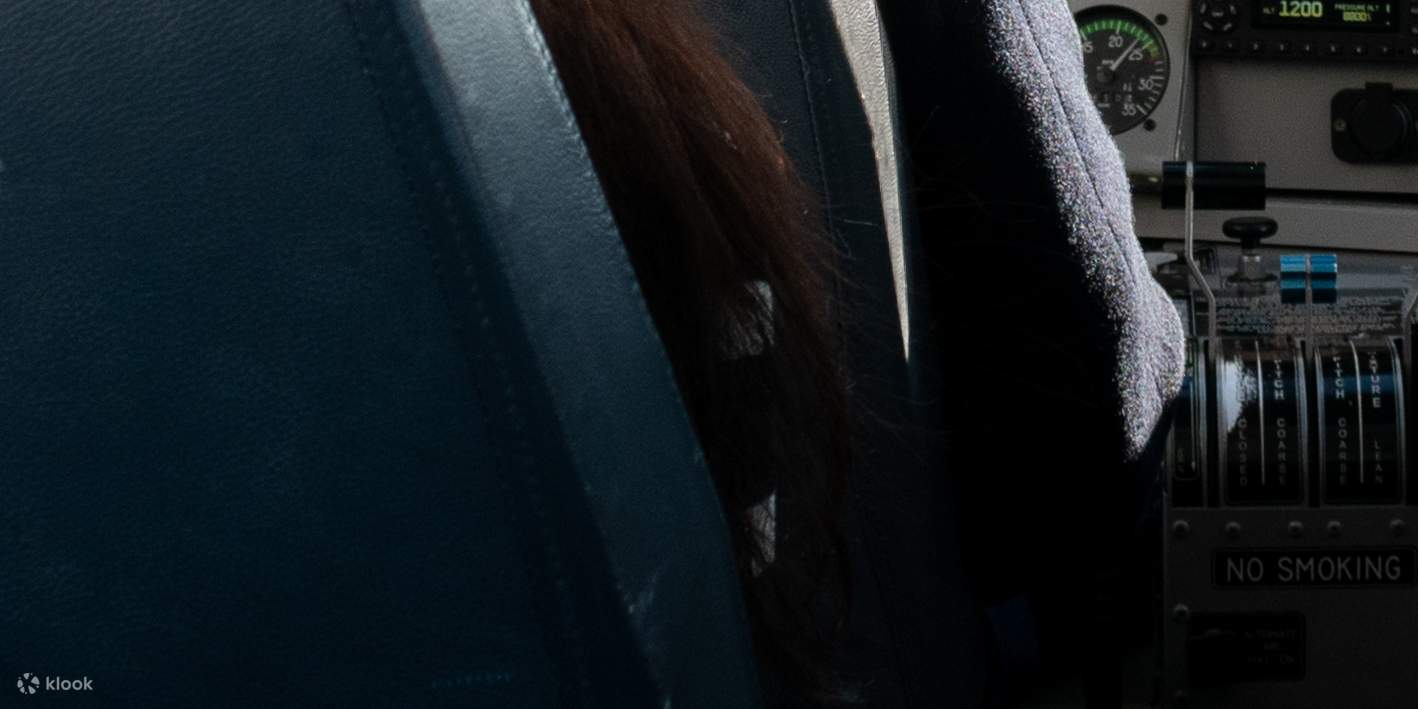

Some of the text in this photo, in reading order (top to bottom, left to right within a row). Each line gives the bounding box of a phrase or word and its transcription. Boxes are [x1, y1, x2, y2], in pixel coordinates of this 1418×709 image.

[1279, 0, 1323, 18] 1200
[1108, 35, 1124, 48] 20
[1138, 78, 1154, 91] 30
[1225, 555, 1402, 583] NO SMOKING
